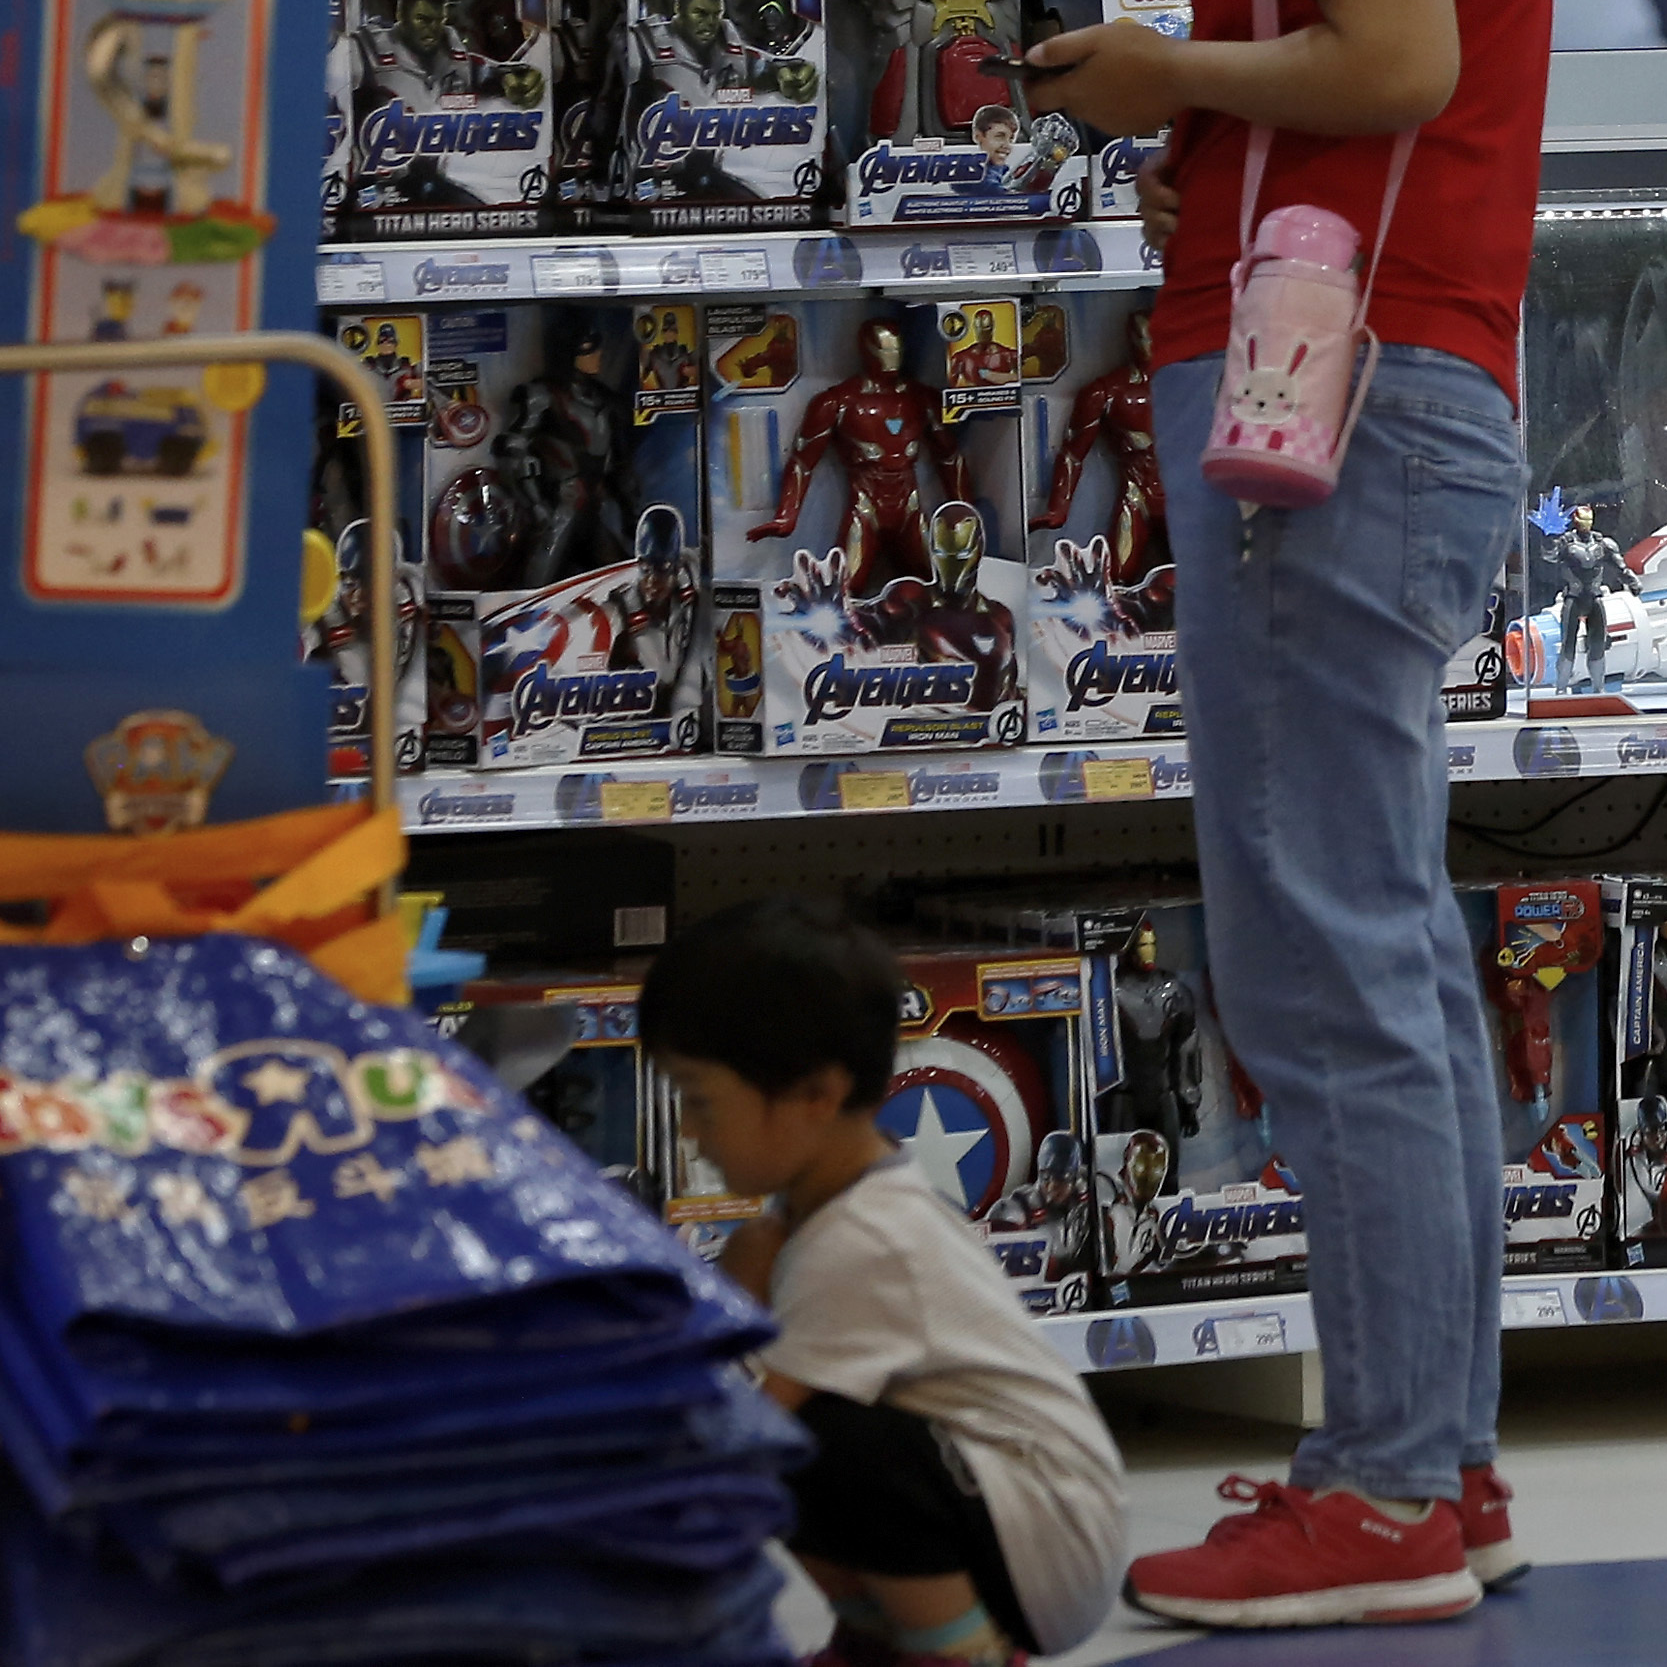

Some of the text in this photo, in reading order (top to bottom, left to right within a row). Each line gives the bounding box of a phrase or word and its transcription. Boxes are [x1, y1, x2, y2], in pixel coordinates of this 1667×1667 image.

[639, 92, 816, 166] AVENGERS
[860, 146, 985, 194] AVENGERS
[515, 667, 655, 732] AVENGERS
[805, 654, 975, 722] AVENGERS
[1633, 941, 1646, 1044] CAPTAIN AMERICA
